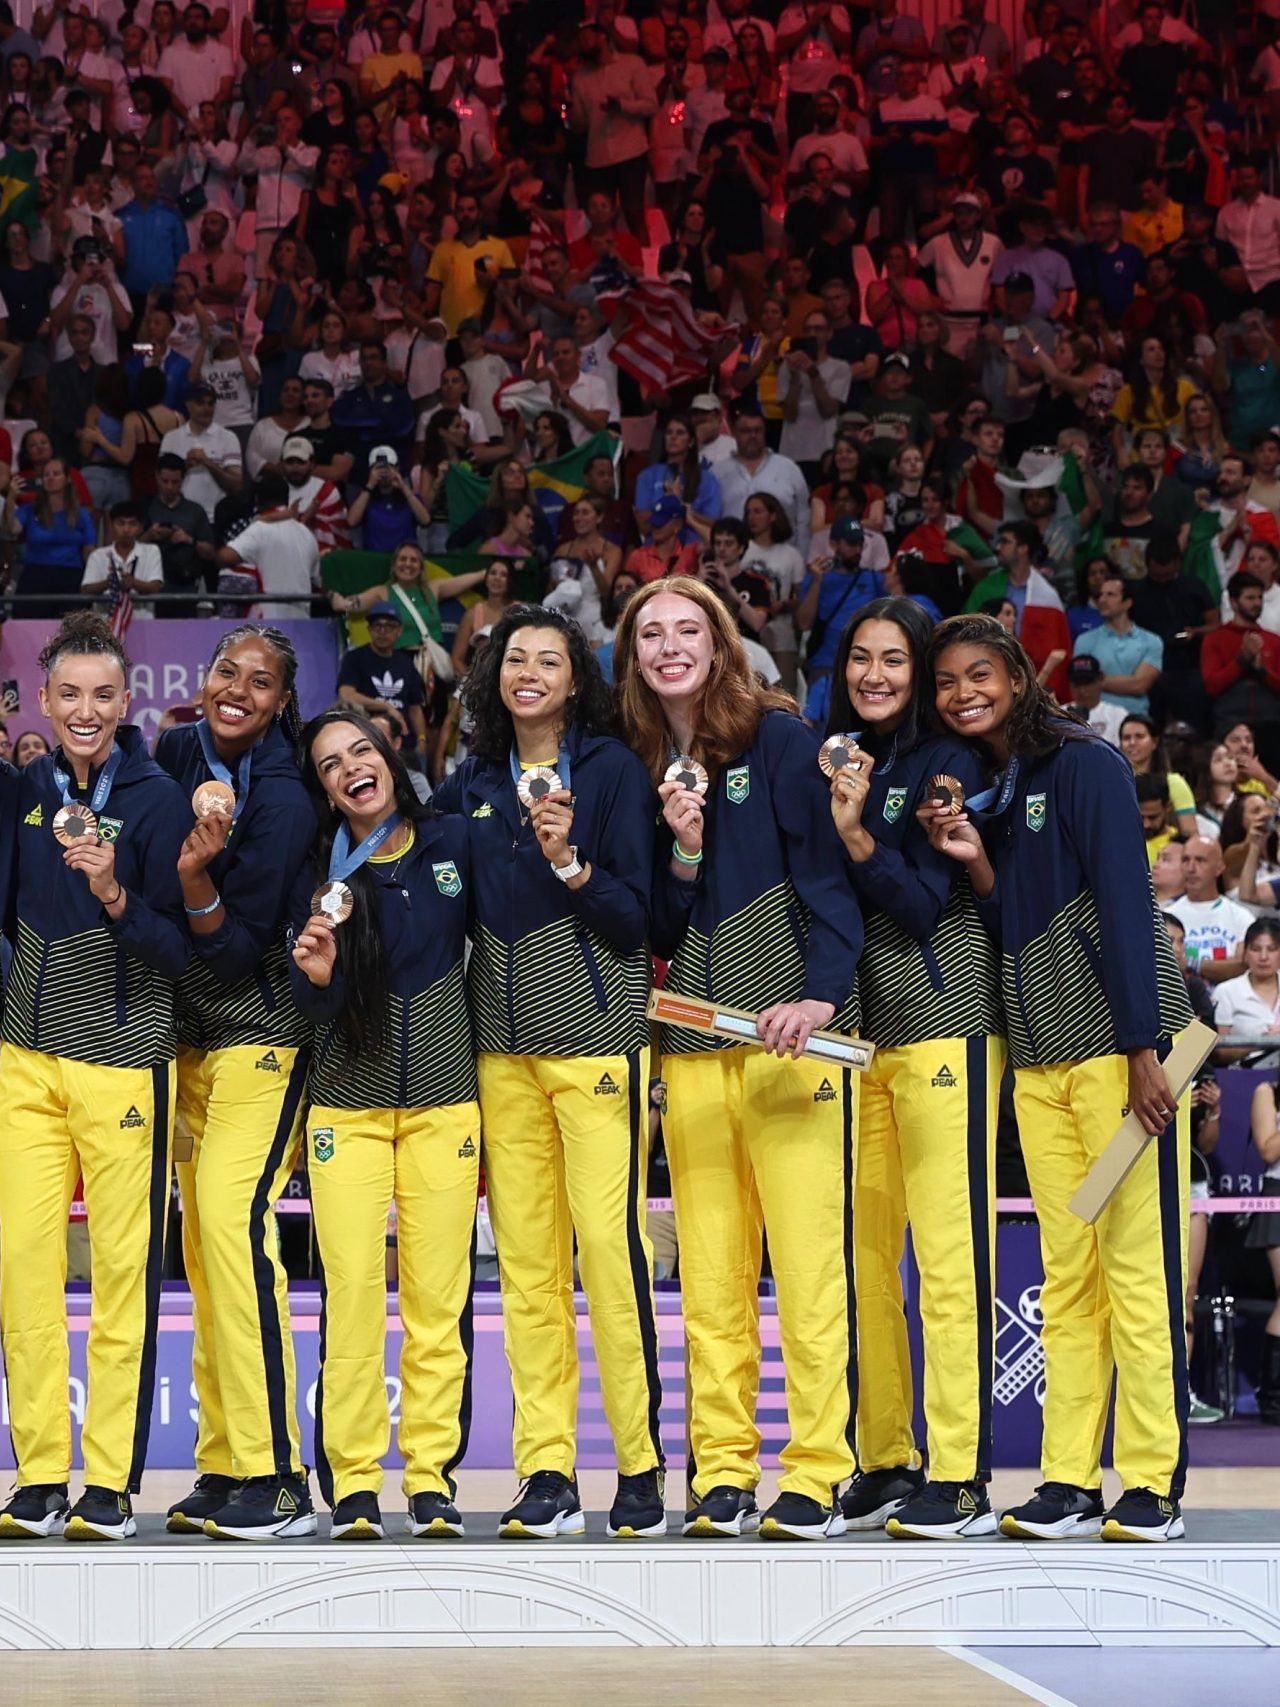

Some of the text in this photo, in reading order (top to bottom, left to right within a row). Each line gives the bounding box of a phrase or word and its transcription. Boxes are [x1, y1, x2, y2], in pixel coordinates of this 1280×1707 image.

[255, 1061, 282, 1073] PEAK
[931, 1078, 958, 1088] PEAK
[594, 1085, 621, 1096] PEAK
[814, 1090, 838, 1102] PEAK
[120, 1118, 145, 1129] PEAK
[458, 1148, 477, 1158] PEAK
